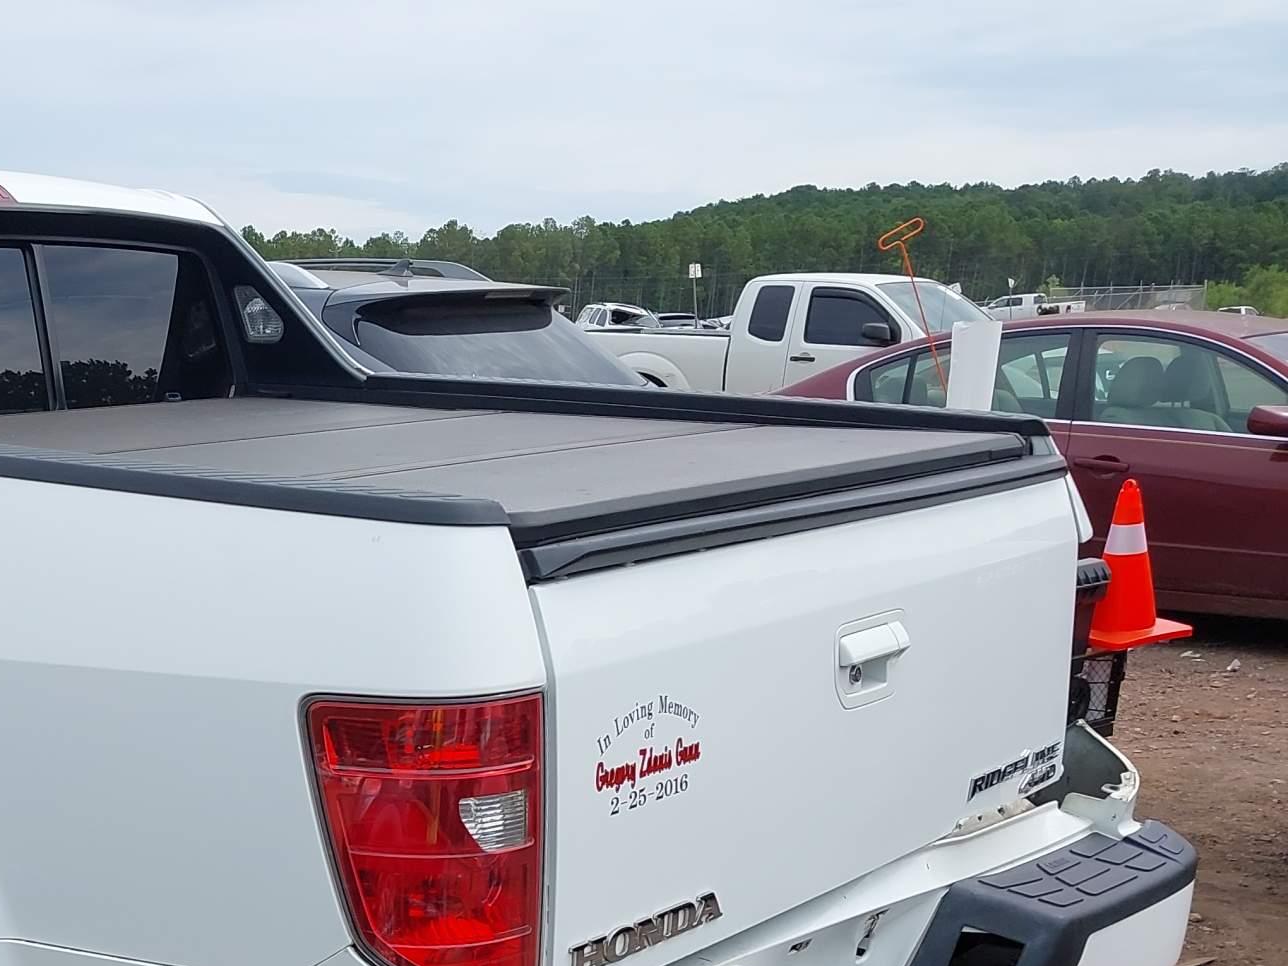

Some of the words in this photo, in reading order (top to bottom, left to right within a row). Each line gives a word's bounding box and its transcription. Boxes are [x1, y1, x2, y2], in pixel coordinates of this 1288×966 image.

[596, 733, 612, 757] In
[614, 701, 654, 737] Loving
[658, 694, 700, 729] Memory
[644, 722, 655, 740] of
[595, 761, 637, 793] Gregory
[967, 740, 1062, 802] RIDGELINE
[610, 773, 689, 816] 2-25-2016
